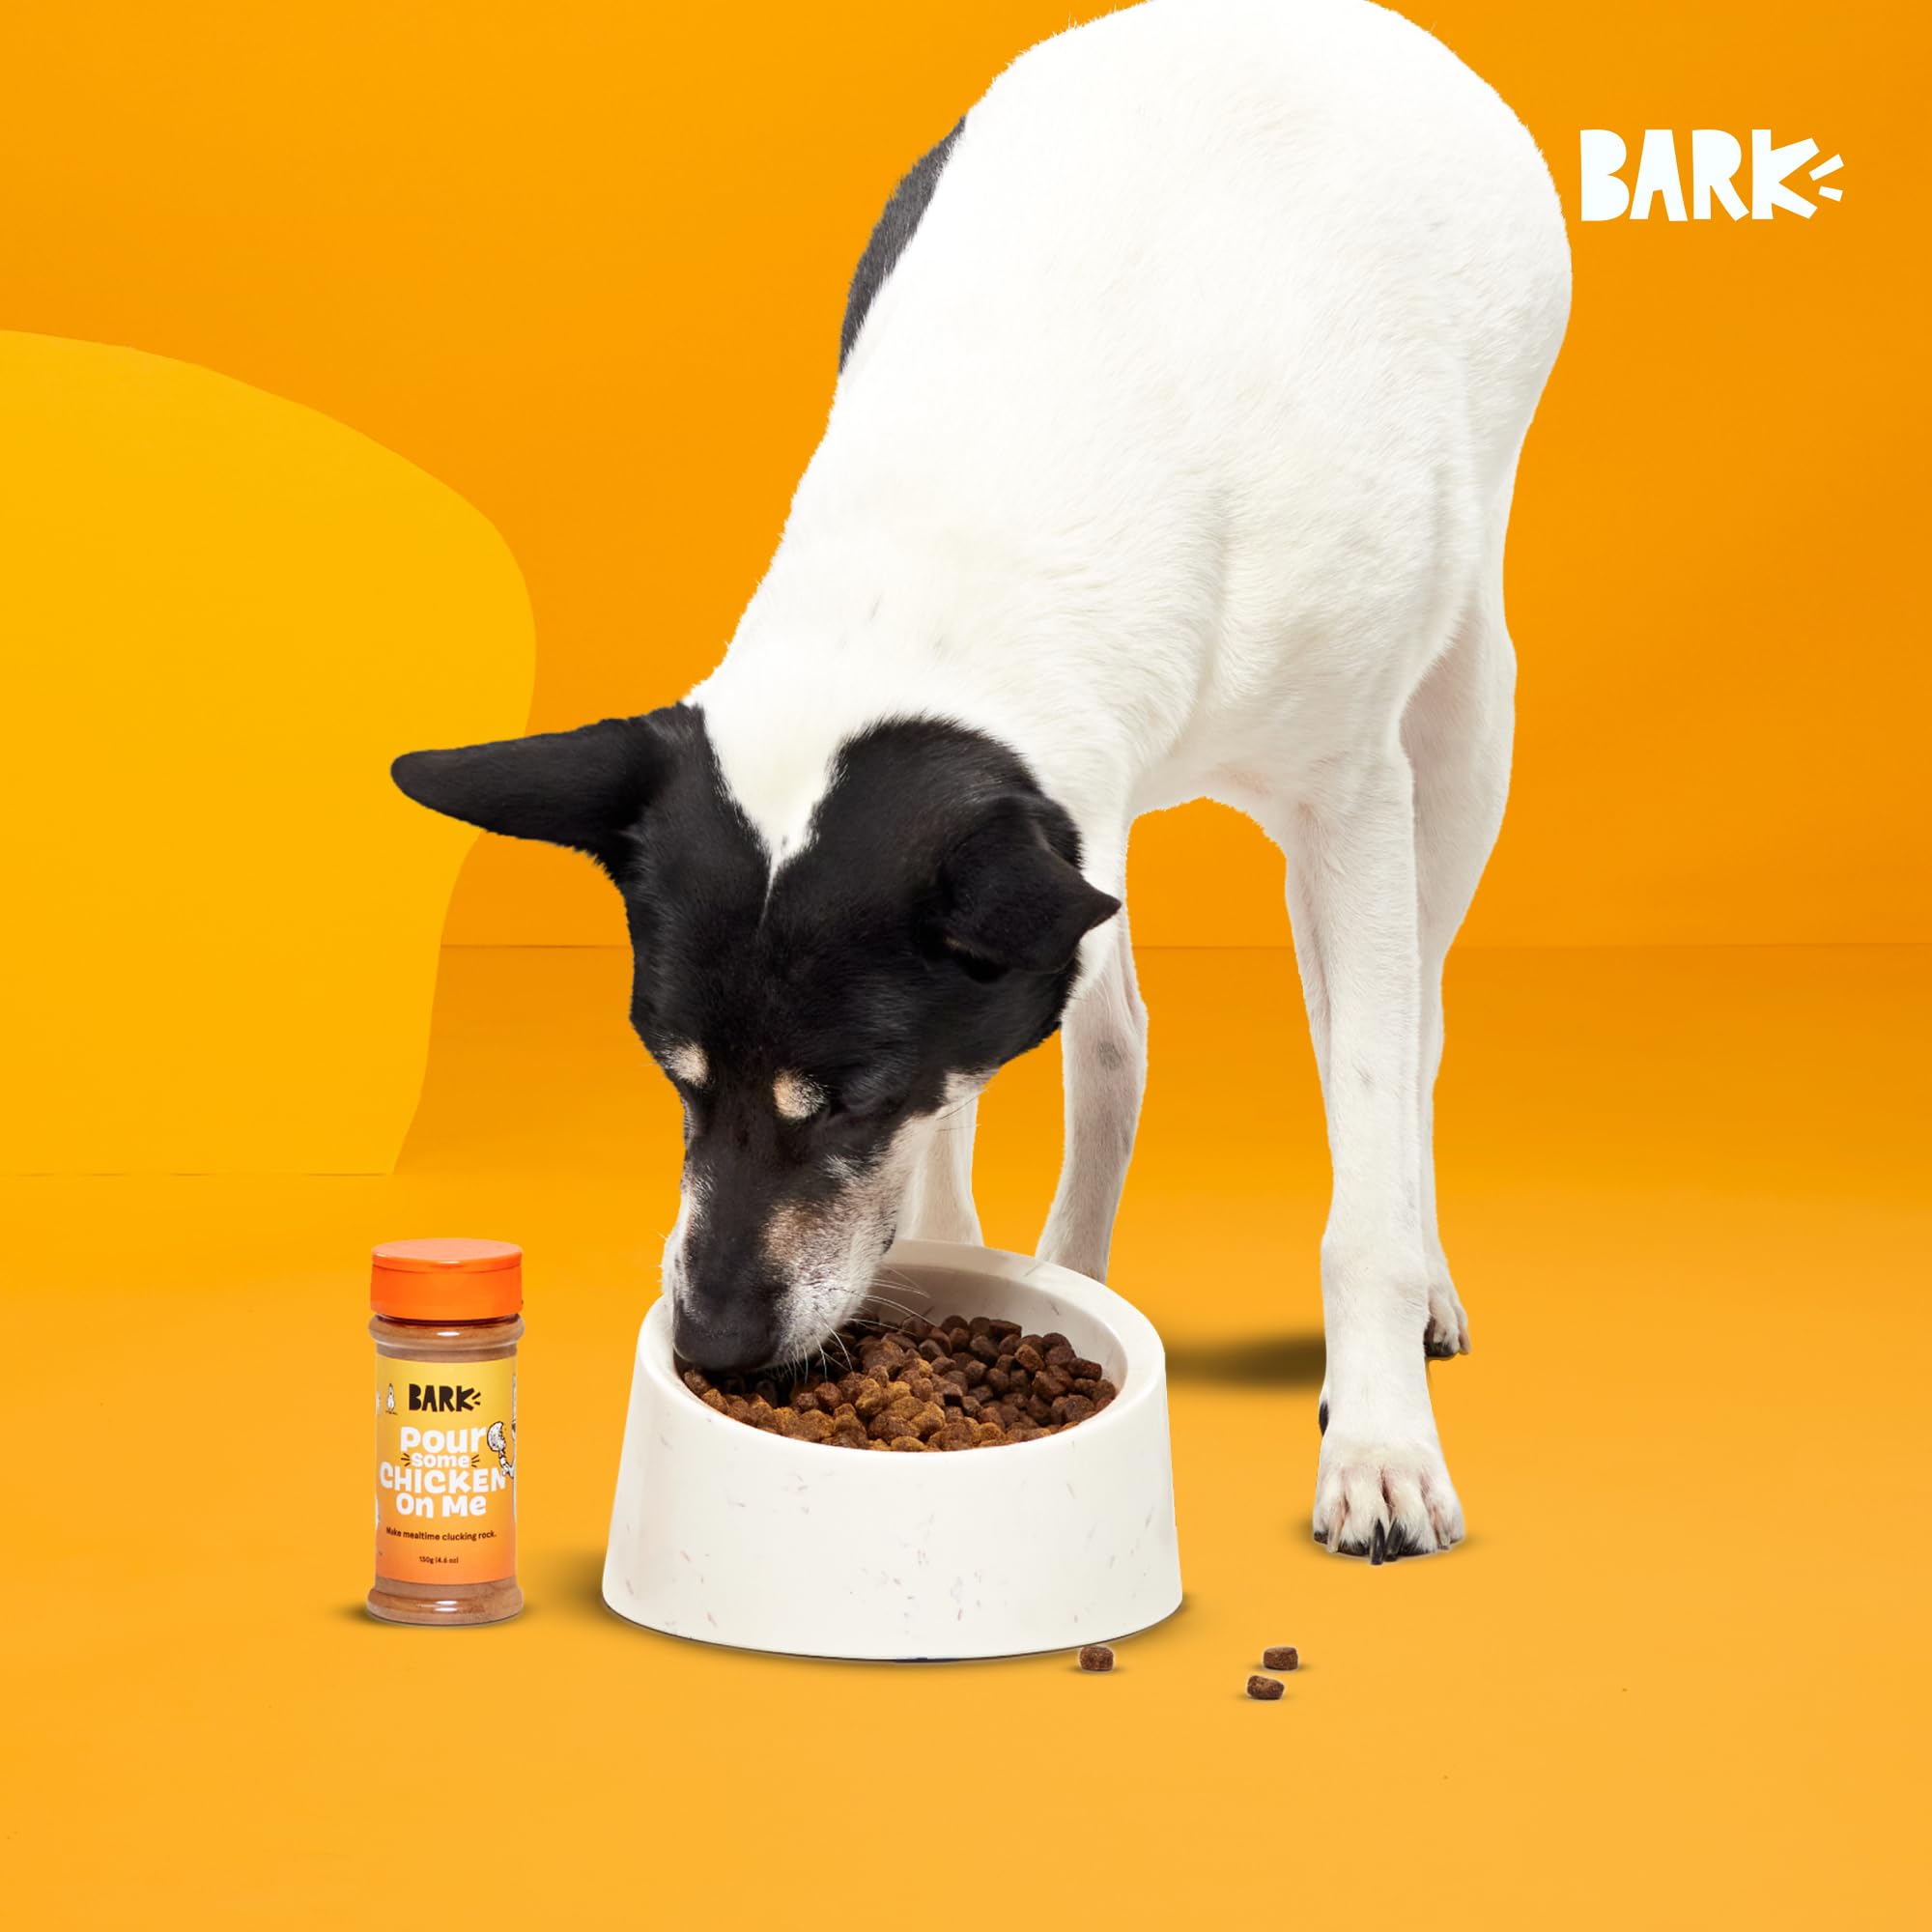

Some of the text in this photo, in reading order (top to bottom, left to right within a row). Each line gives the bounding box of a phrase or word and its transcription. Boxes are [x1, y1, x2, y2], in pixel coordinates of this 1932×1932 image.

[409, 1383, 475, 1412] BARK
[411, 1452, 470, 1468] some
[380, 1462, 507, 1494] CHICKEN
[395, 1492, 488, 1519] On Me
[385, 1526, 497, 1542] Make mealtime clucking rock.
